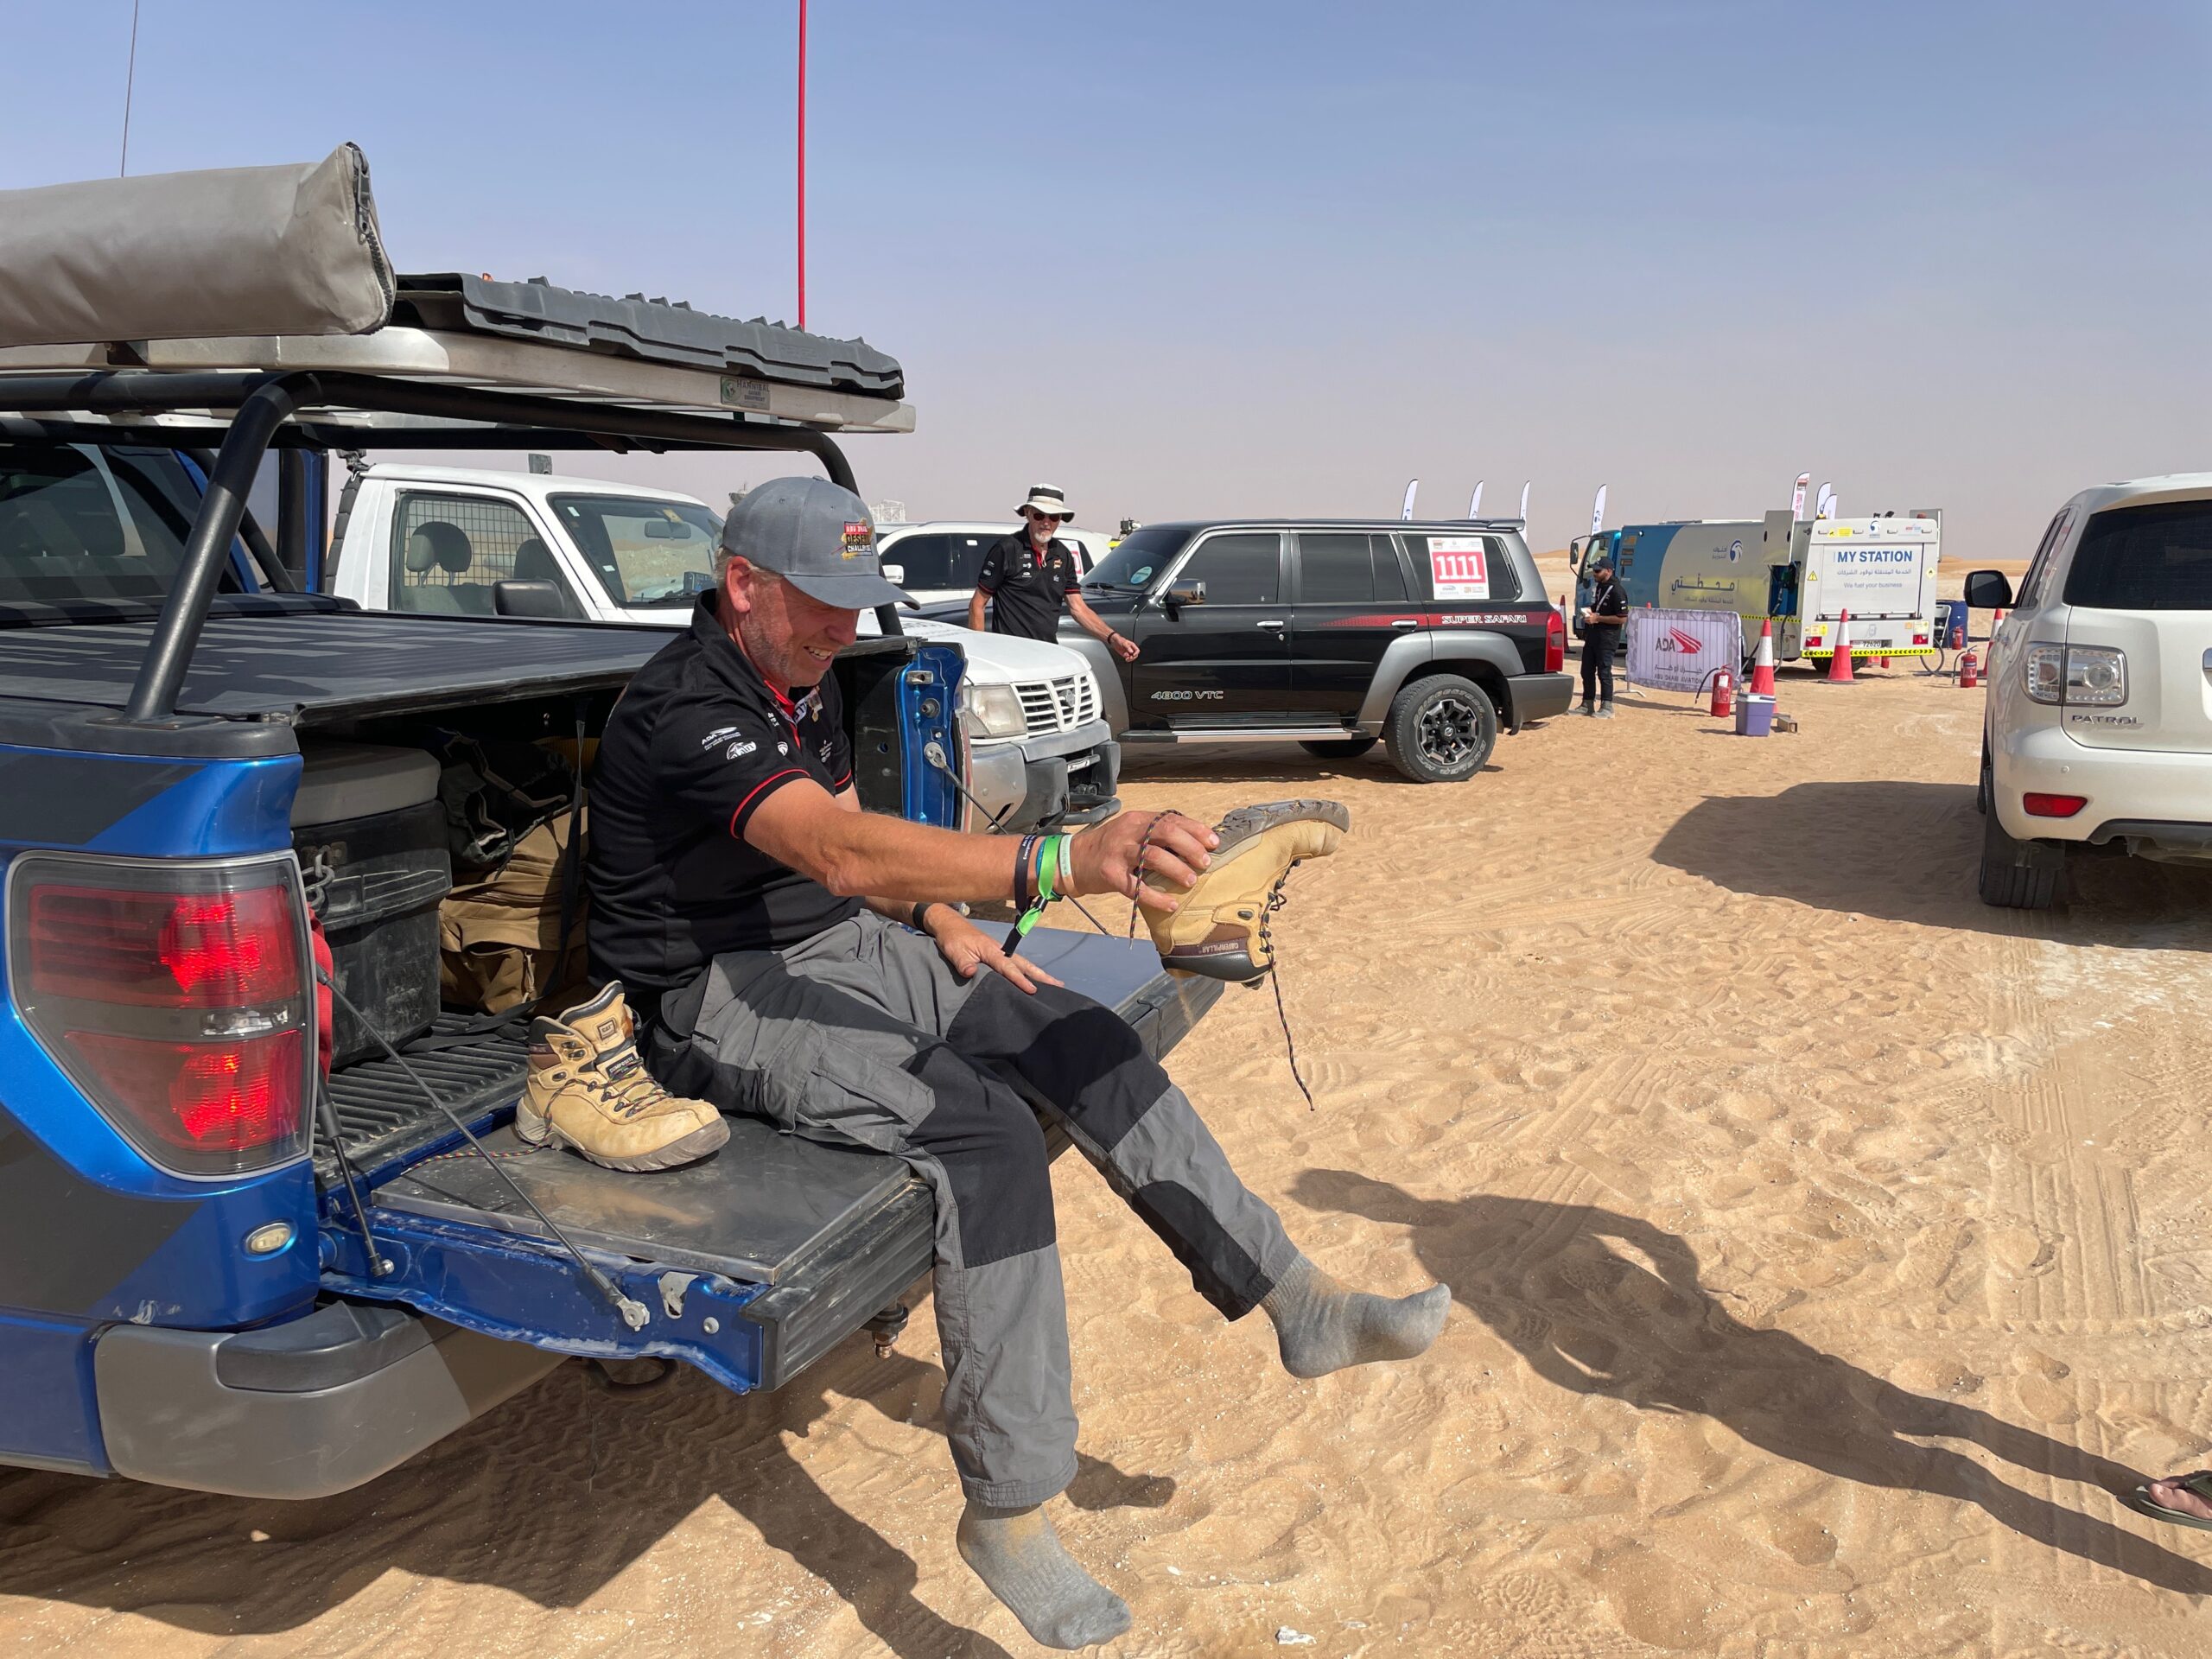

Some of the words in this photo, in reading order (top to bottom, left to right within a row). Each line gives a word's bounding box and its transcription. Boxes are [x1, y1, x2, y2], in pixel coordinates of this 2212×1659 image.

[1837, 551, 1857, 563] MY
[1859, 550, 1913, 563] STATION
[1435, 555, 1482, 581] 1111
[1441, 614, 1483, 624] SUPER
[1484, 614, 1527, 624] SAFARI
[1151, 690, 1192, 700] 4800
[1194, 690, 1224, 700] VTC
[2072, 715, 2144, 726] PATROL
[1202, 943, 1239, 954] CATERPILLAR
